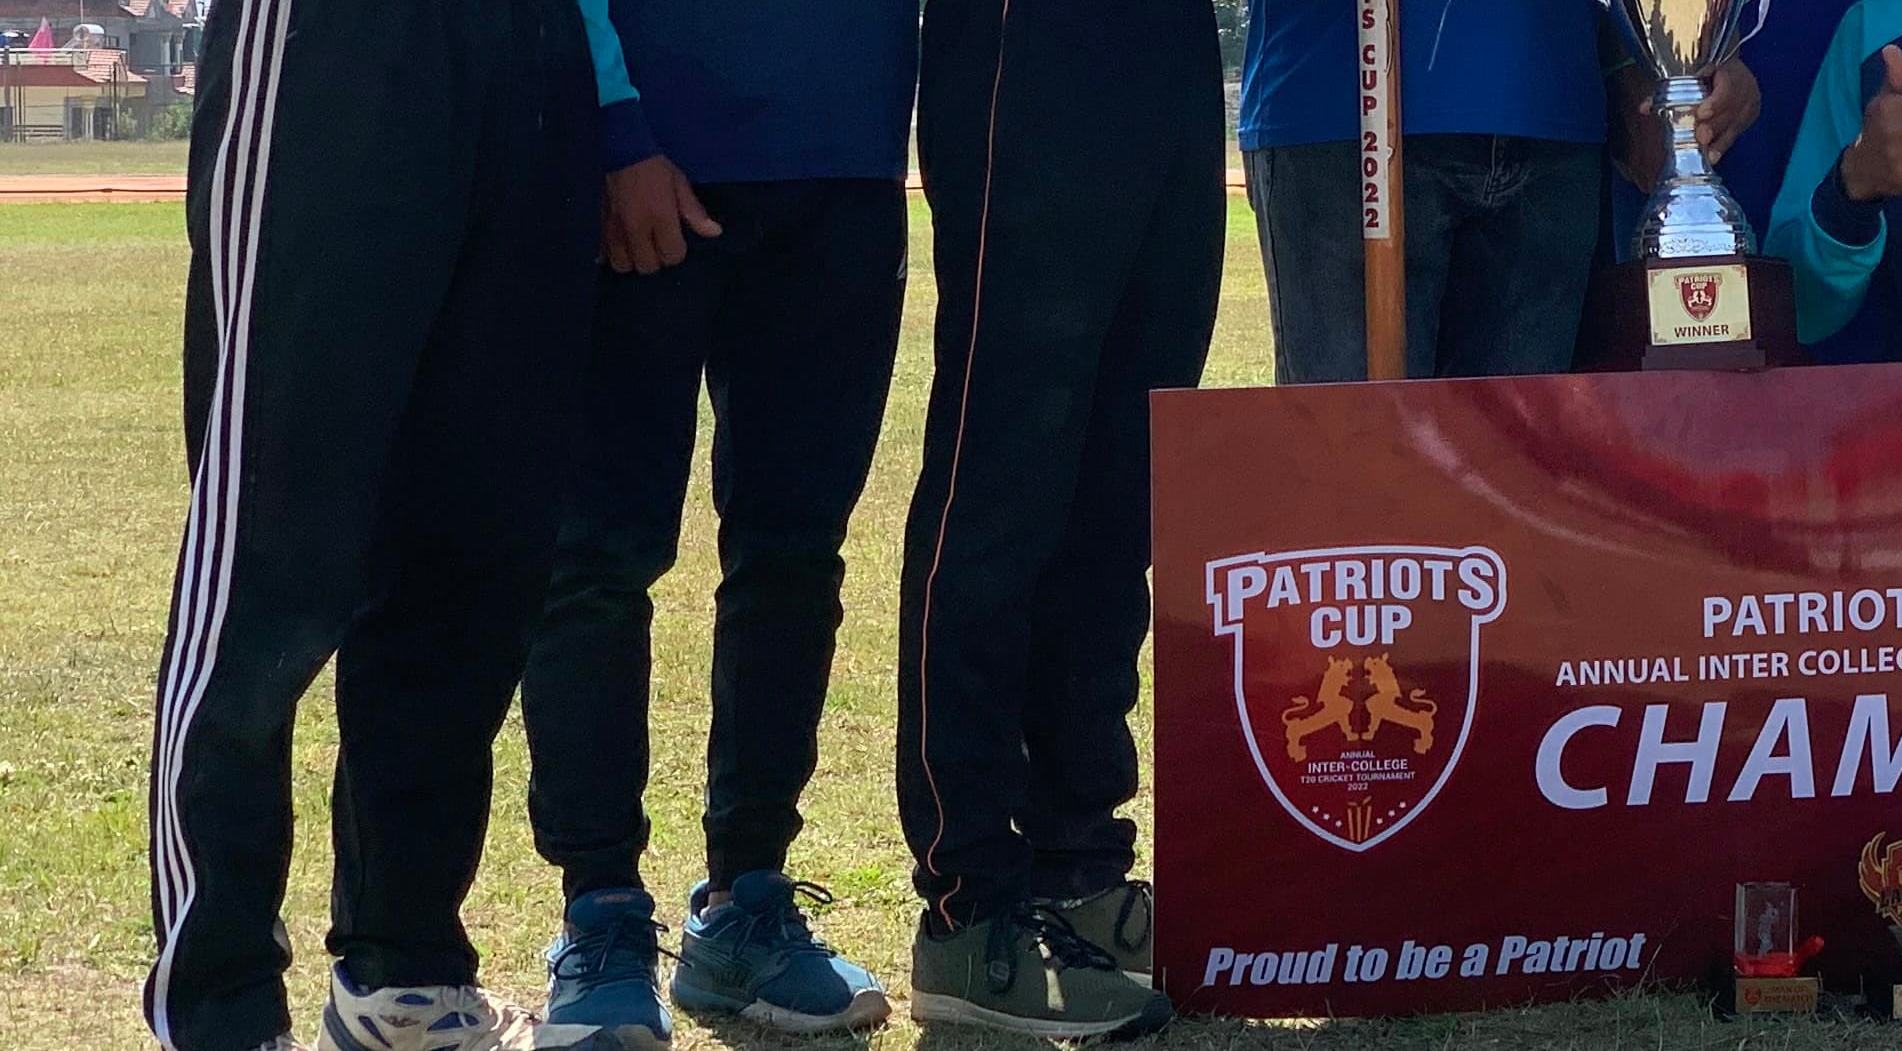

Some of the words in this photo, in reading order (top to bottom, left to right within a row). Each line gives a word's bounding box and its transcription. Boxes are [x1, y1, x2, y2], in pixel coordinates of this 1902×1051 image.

[1362, 45, 1377, 116] CUP
[1363, 131, 1379, 229] 2022
[1674, 324, 1729, 338] WINNER
[1227, 557, 1494, 622] PATRIOTS
[1310, 604, 1412, 649] CUP
[1555, 657, 1689, 686] ANNUAL
[1699, 651, 1789, 680] INTER
[1308, 758, 1409, 774] INTER-COLLEGE
[1340, 750, 1376, 760] ANNUAL
[1318, 774, 1353, 784] CRICKET
[1356, 771, 1416, 782] TOURNAMENT
[1347, 782, 1369, 791] 2022
[1203, 944, 1339, 987] Proud
[1343, 944, 1388, 983] to
[1395, 940, 1452, 981] be
[1460, 942, 1490, 978] a
[1495, 932, 1647, 976] Patriot
